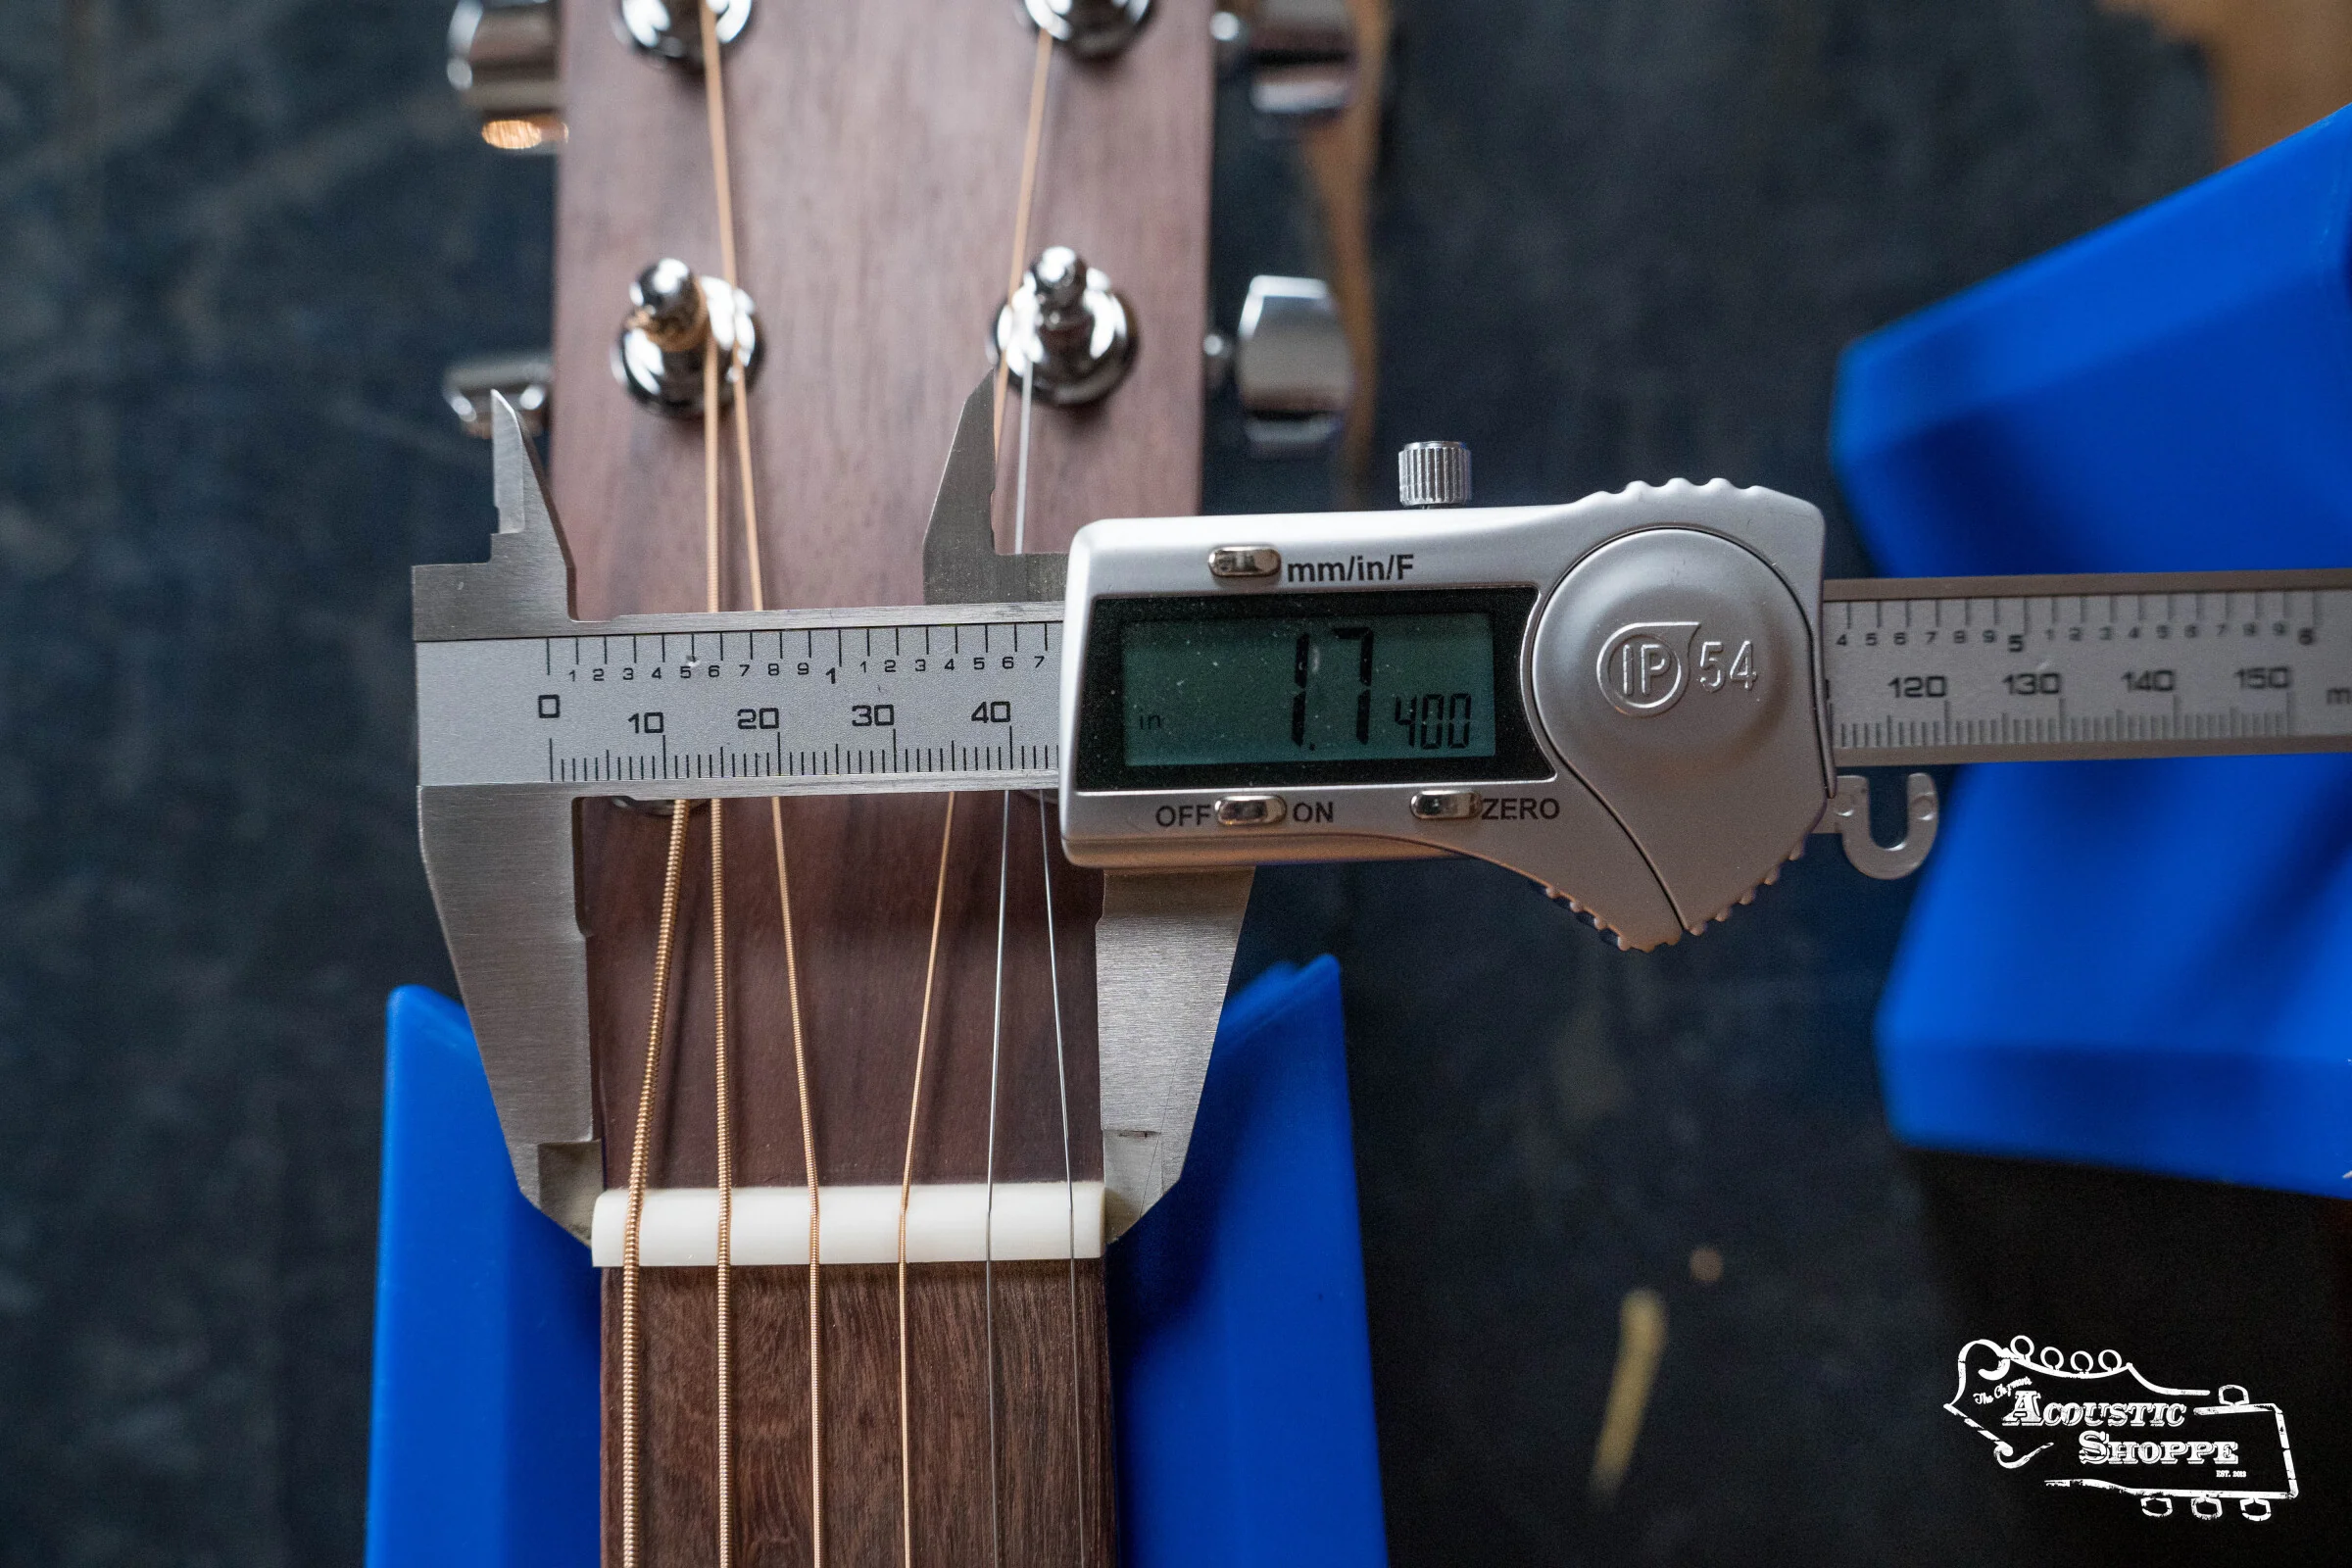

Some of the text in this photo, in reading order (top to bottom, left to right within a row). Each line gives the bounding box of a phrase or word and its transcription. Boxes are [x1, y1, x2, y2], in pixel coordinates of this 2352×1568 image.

[1287, 554, 1415, 583] mm/in/F
[1836, 633, 1847, 647] 4
[1865, 632, 1878, 646] 5
[1893, 631, 1907, 646] 6
[1925, 630, 1937, 645] 7
[1953, 629, 1967, 644] 8
[1983, 629, 1996, 644] 9
[2008, 634, 2024, 653] 5
[2069, 626, 2082, 642] 2
[2098, 625, 2112, 641] 3
[2129, 625, 2140, 639] 4
[2215, 622, 2227, 636] 7
[2297, 626, 2315, 646] 6
[568, 656, 1045, 684] 1 2 3 4 5 6 7 8 9 1 1 2 3 4 5 6 7
[1622, 640, 1757, 696] IP 54
[1887, 675, 1947, 699] 120
[2001, 671, 2061, 696] 130
[2120, 669, 2176, 693] 140
[2233, 665, 2290, 690] 150
[538, 694, 1011, 734] 0 10 20 30 40
[1155, 797, 1560, 827] OFF ON ZERO
